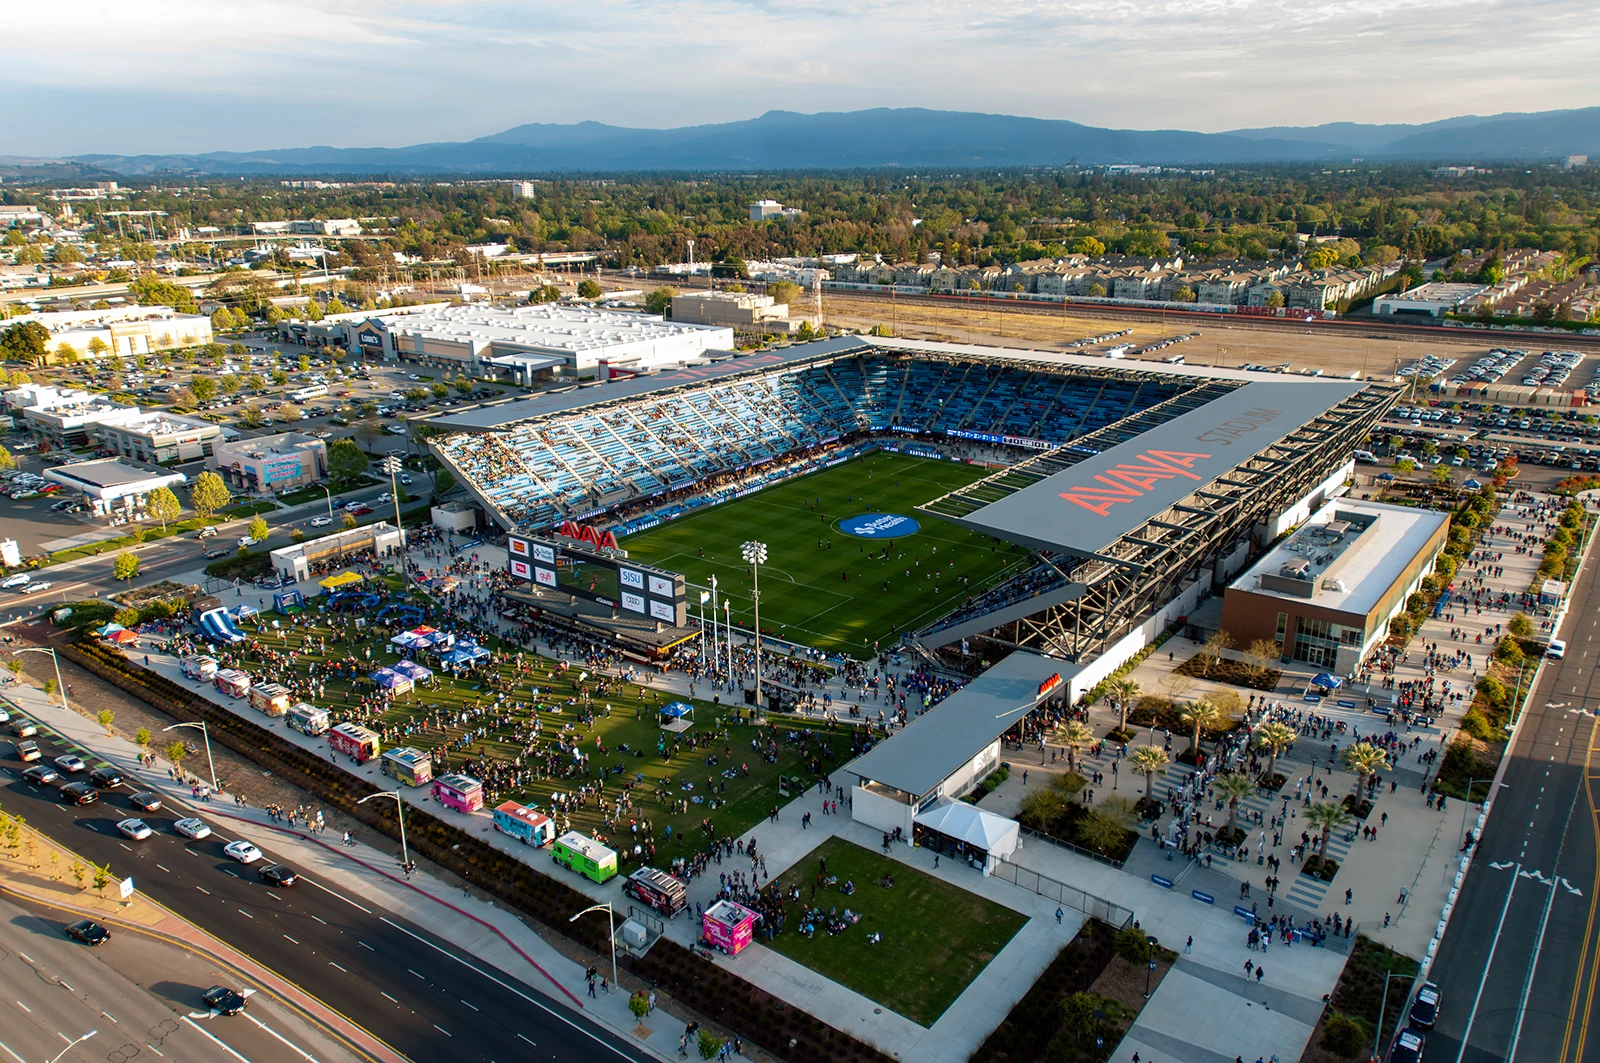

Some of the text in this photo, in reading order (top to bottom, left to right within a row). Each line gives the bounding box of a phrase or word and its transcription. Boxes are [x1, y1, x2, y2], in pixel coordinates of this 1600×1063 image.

[361, 334, 378, 344] LOWE'S
[1196, 407, 1285, 446] STADIUM
[1058, 450, 1212, 517] AVAYA
[561, 521, 618, 551] AVAYA
[539, 572, 552, 582] gyft
[622, 571, 641, 584] SJSU
